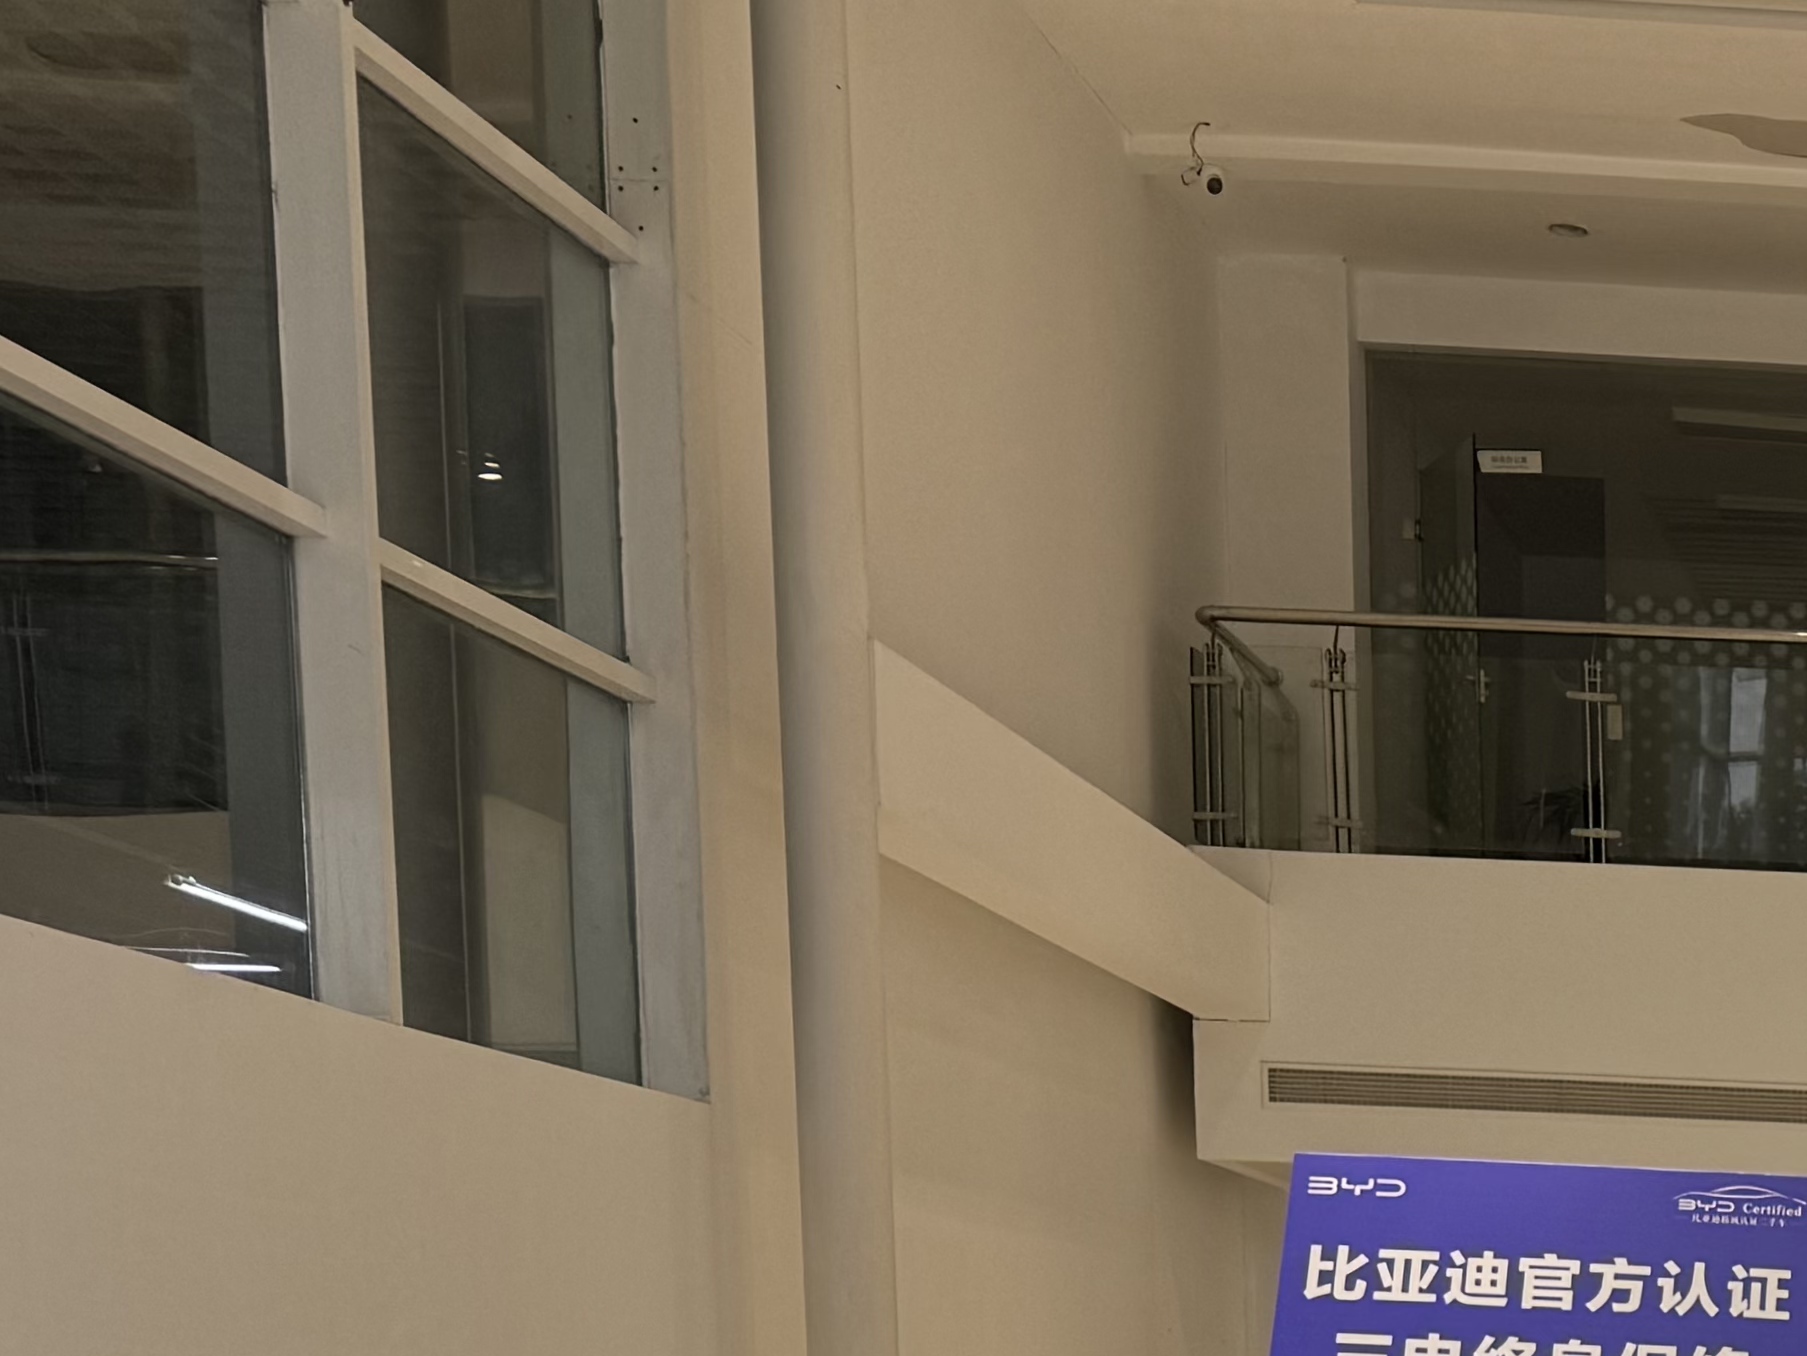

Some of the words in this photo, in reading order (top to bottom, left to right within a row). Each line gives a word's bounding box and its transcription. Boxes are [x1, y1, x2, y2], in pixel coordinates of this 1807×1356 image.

[1308, 1176, 1407, 1198] BYD
[1678, 1199, 1735, 1212] BYD
[1743, 1202, 1803, 1217] Certified
[1303, 1244, 1793, 1321] 比亚迪官方认证
